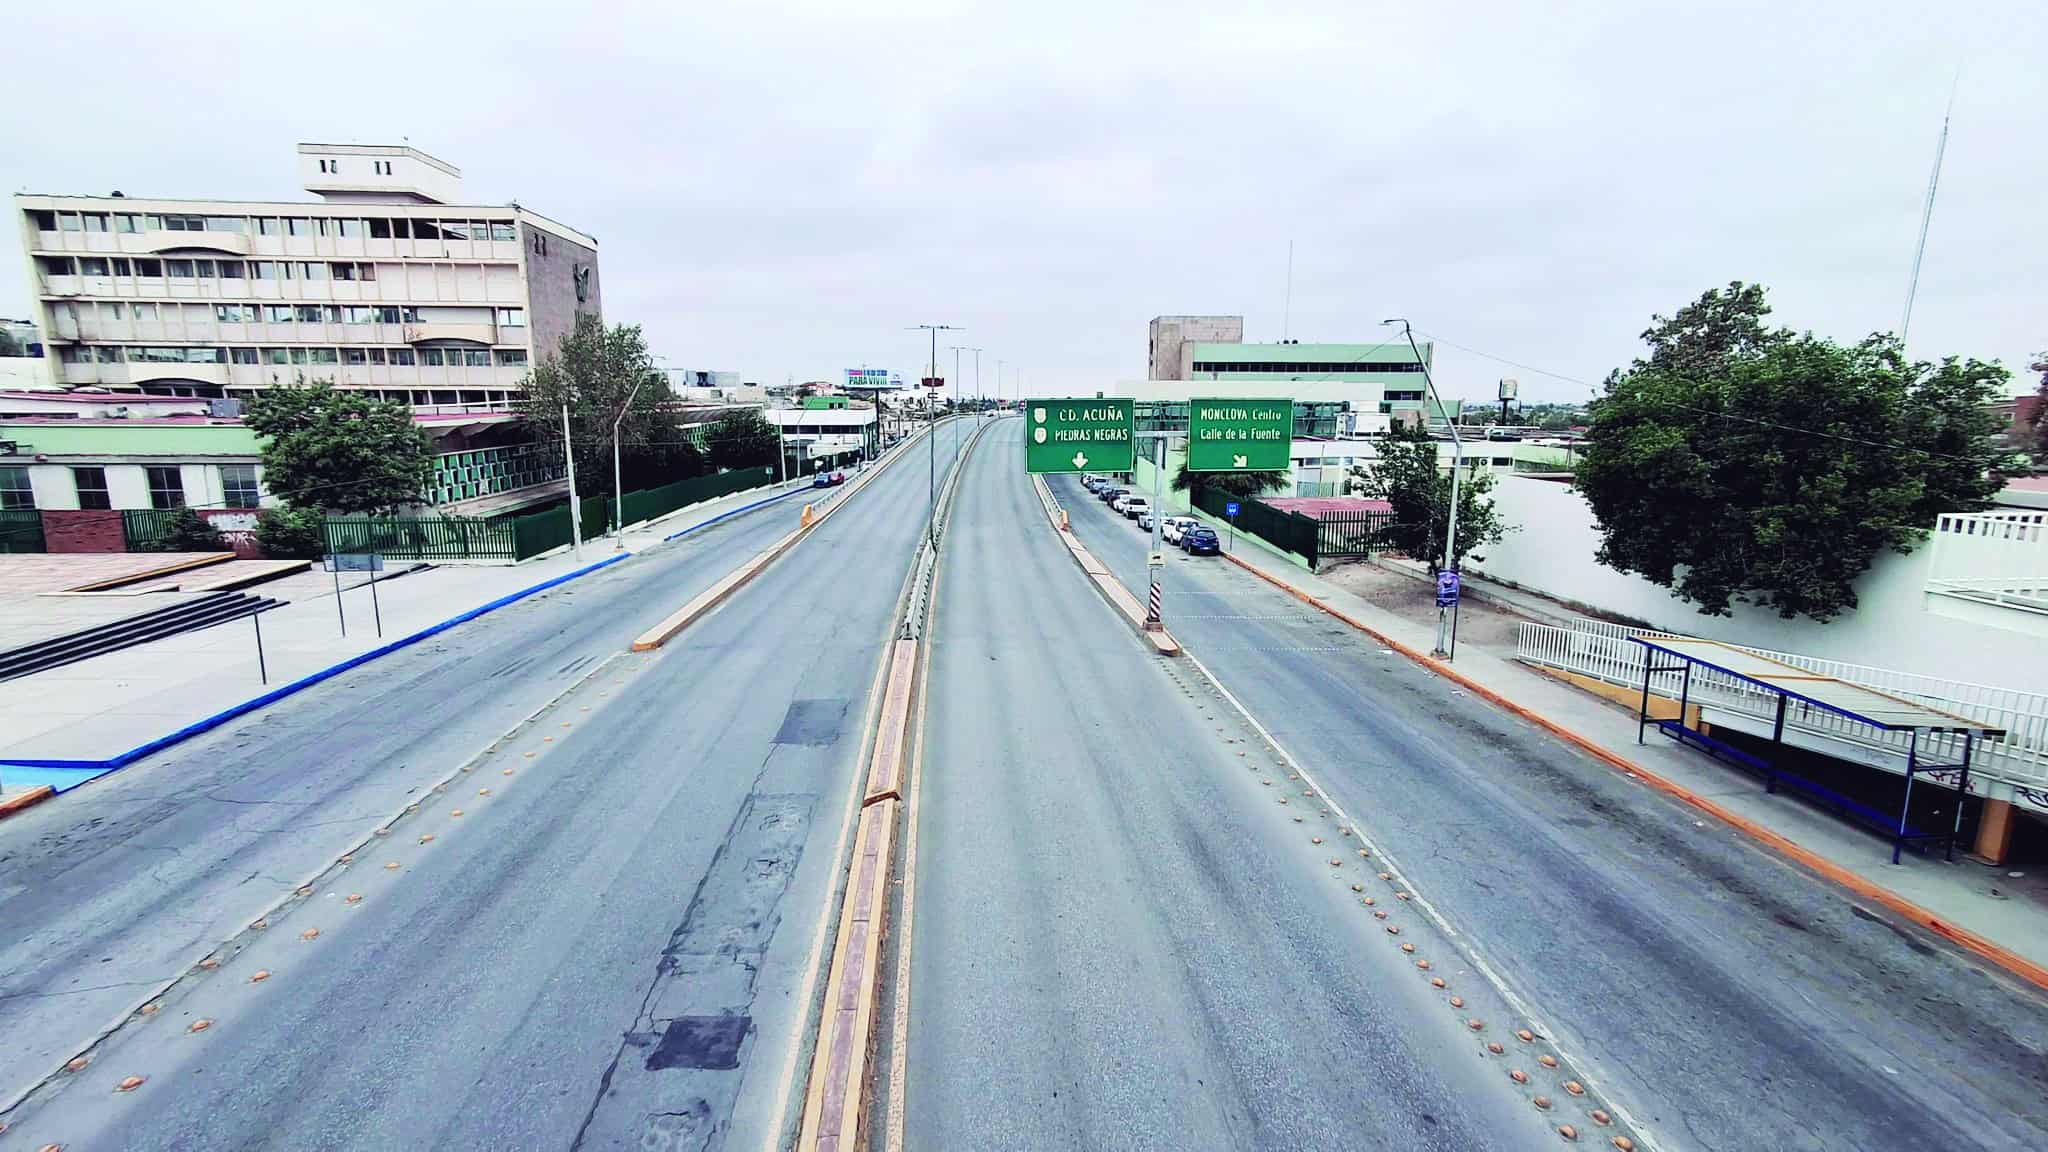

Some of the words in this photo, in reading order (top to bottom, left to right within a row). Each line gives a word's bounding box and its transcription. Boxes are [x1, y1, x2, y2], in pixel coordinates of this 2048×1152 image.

[1060, 409, 1079, 421] CD.
[1083, 405, 1123, 421] ACUÑA
[1200, 408, 1248, 420] MONCLOVA
[1252, 408, 1281, 420] Centro
[1055, 429, 1090, 441] PIEDRAS
[1094, 428, 1128, 441] NEGRAS
[1200, 428, 1222, 440] Calle
[1225, 428, 1236, 440] de
[1239, 428, 1247, 440] la
[1251, 428, 1281, 440] Fuente
